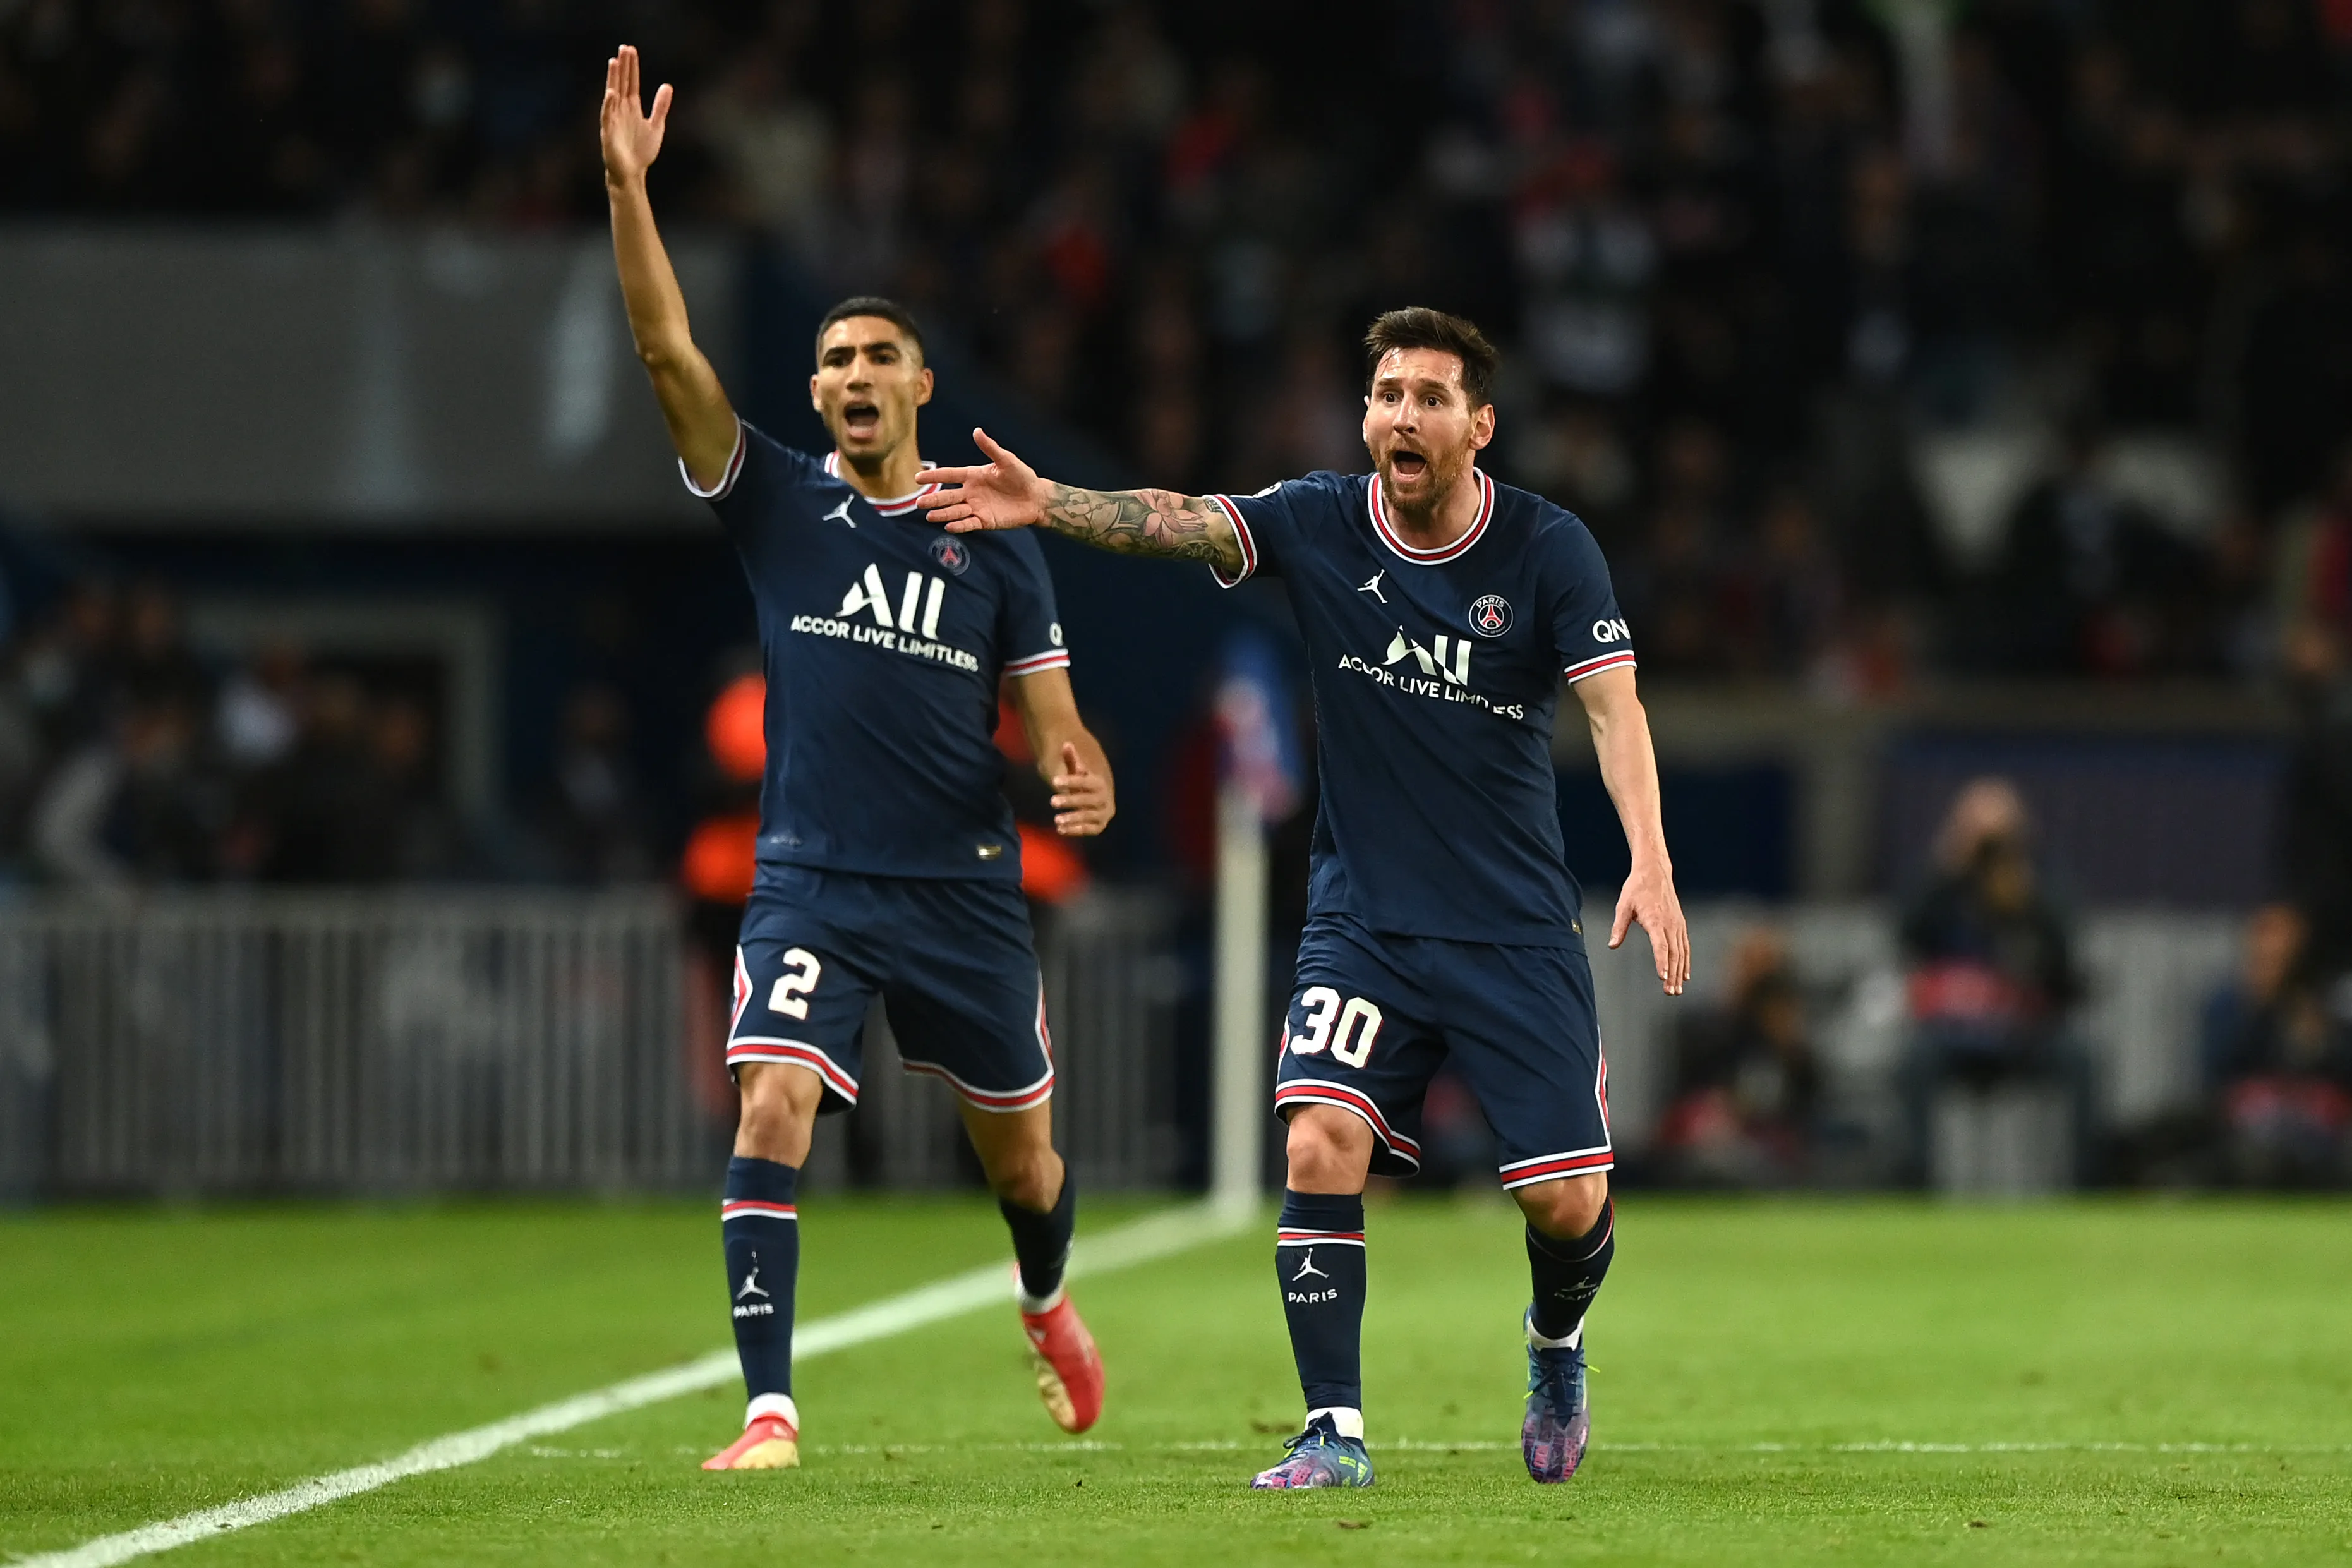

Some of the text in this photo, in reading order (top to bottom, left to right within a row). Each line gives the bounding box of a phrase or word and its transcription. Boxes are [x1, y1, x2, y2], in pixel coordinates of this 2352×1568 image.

[1476, 597, 1505, 608] PARIS
[790, 614, 979, 672] ACCOR LIVE LIMITLESS
[1593, 618, 1631, 643] QN
[1399, 675, 1441, 698] LIVE
[768, 947, 821, 1021] 2
[1290, 986, 1384, 1069] 30
[1288, 1289, 1338, 1304] PARIS
